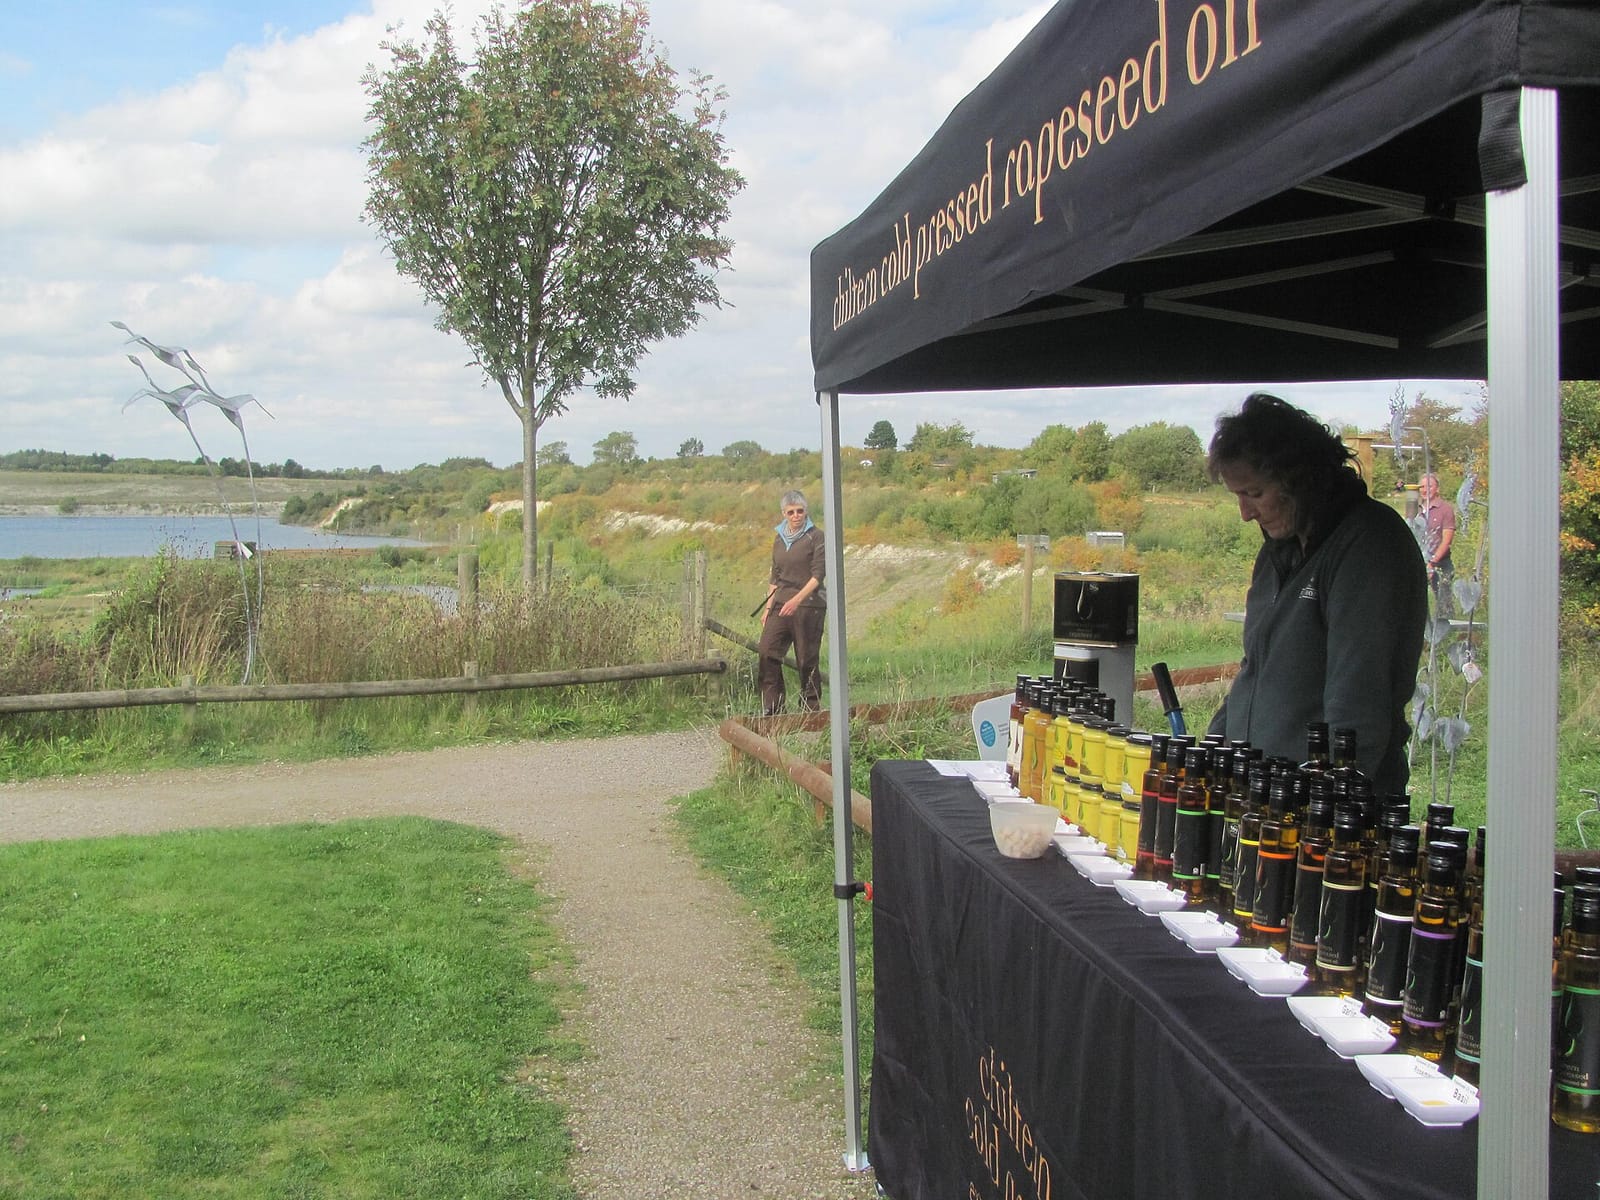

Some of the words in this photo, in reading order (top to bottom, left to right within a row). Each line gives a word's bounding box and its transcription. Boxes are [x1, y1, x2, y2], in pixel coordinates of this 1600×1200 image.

[832, 266, 877, 332] chiltern
[880, 211, 912, 297] cold
[913, 138, 993, 300] pressed
[1002, 0, 1168, 224] rapeseed
